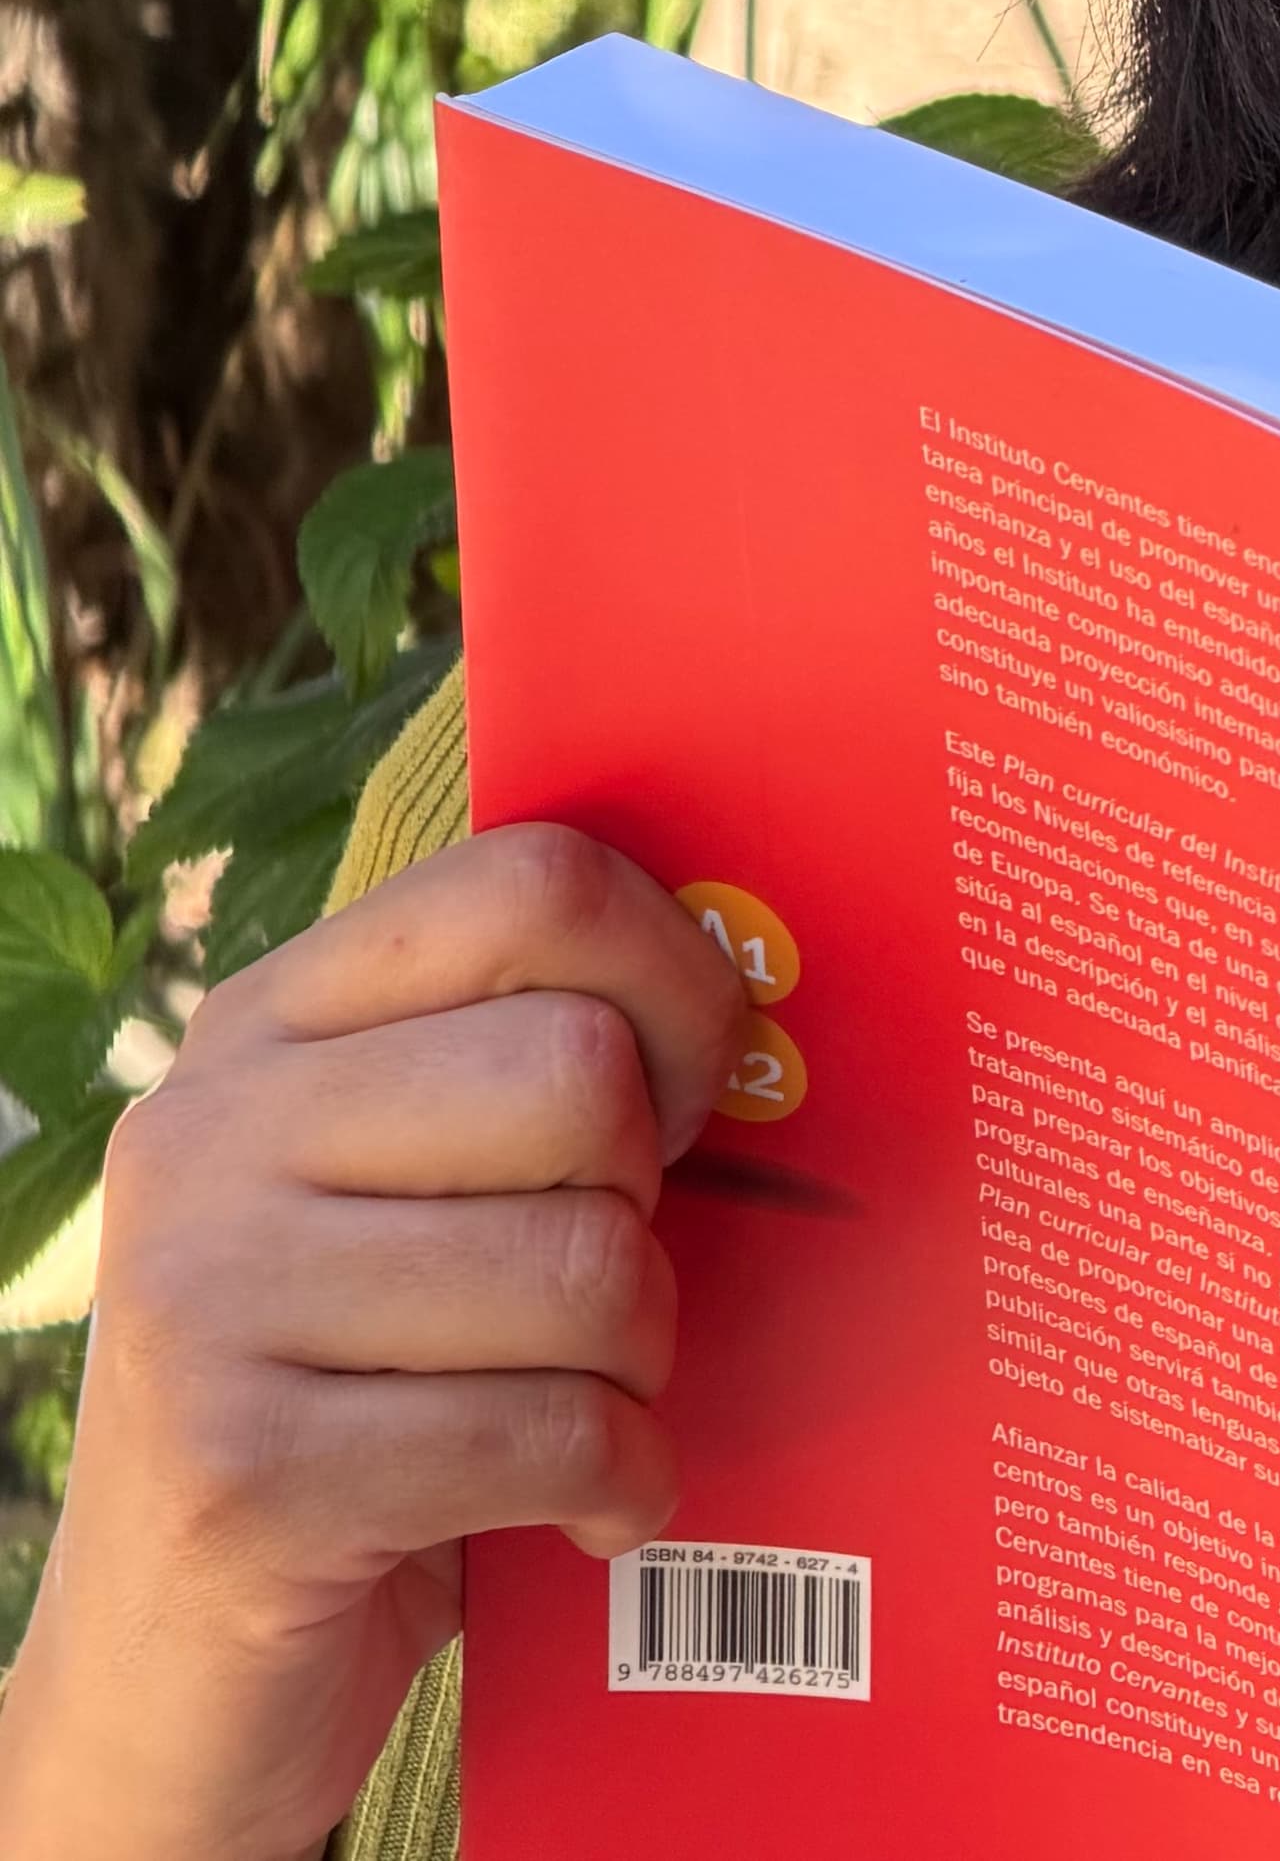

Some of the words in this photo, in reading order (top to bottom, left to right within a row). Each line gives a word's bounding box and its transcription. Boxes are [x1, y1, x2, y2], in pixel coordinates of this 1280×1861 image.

[919, 405, 941, 433] El
[949, 417, 1046, 475] Instituto
[1052, 461, 1171, 528] Cervantes
[1177, 514, 1236, 557] tiene
[922, 443, 983, 485] tarea
[991, 475, 1094, 531] principal
[1101, 519, 1131, 547] de
[1139, 537, 1250, 598] promover
[934, 592, 1052, 653] adecuada
[1060, 643, 1186, 712] proyección
[936, 628, 1057, 690] constituye
[1064, 680, 1094, 707] un
[1101, 695, 1232, 766] valiosísimo
[944, 729, 996, 768] Este
[1003, 753, 1055, 793] Plan
[1062, 783, 1175, 842] curricular
[1180, 833, 1217, 862] del
[946, 765, 984, 798] fija
[991, 782, 1027, 815] los
[1033, 799, 1119, 853] Niveles
[1125, 841, 1155, 869] de
[1162, 859, 1277, 924] referencia
[960, 946, 1006, 976] que
[1013, 966, 1058, 997] una
[1065, 988, 1182, 1050] adecuada
[728, 1052, 785, 1102] 2
[965, 1010, 998, 1040] Se
[1005, 1029, 1107, 1084] presenta
[1115, 1075, 1166, 1110] aquí
[1173, 1099, 1202, 1127] un
[967, 1045, 1104, 1116] tratamiento
[1111, 1106, 1243, 1177] sistemático
[1249, 1167, 1279, 1194] de
[973, 1117, 1100, 1180] programas
[1106, 1169, 1136, 1196] de
[1143, 1186, 1273, 1257] enseñanza.
[978, 1182, 1030, 1219] Plan
[1038, 1210, 1151, 1266] curricular
[1156, 1257, 1193, 1285] del
[988, 1357, 1065, 1397] objeto
[1072, 1385, 1102, 1411] de
[1109, 1400, 1248, 1472] sistematizar
[1253, 1463, 1280, 1487] su
[991, 1422, 1089, 1471] Afianzar
[1095, 1455, 1117, 1482] la
[1124, 1472, 1211, 1520] calidad
[1217, 1509, 1247, 1535] de
[1254, 1521, 1275, 1549] la
[993, 1460, 1083, 1503] centros
[1090, 1492, 1118, 1515] es
[1125, 1504, 1155, 1530] un
[1162, 1519, 1254, 1570] objetivo
[640, 1548, 686, 1562] ISBN
[996, 1565, 1128, 1617] programas
[1135, 1606, 1188, 1639] para
[1196, 1624, 1217, 1651] la
[651, 1663, 743, 1683] 788497
[756, 1666, 850, 1689] 426275
[997, 1670, 1097, 1709] español
[1105, 1697, 1243, 1757] constituyen
[1251, 1745, 1280, 1772] un
